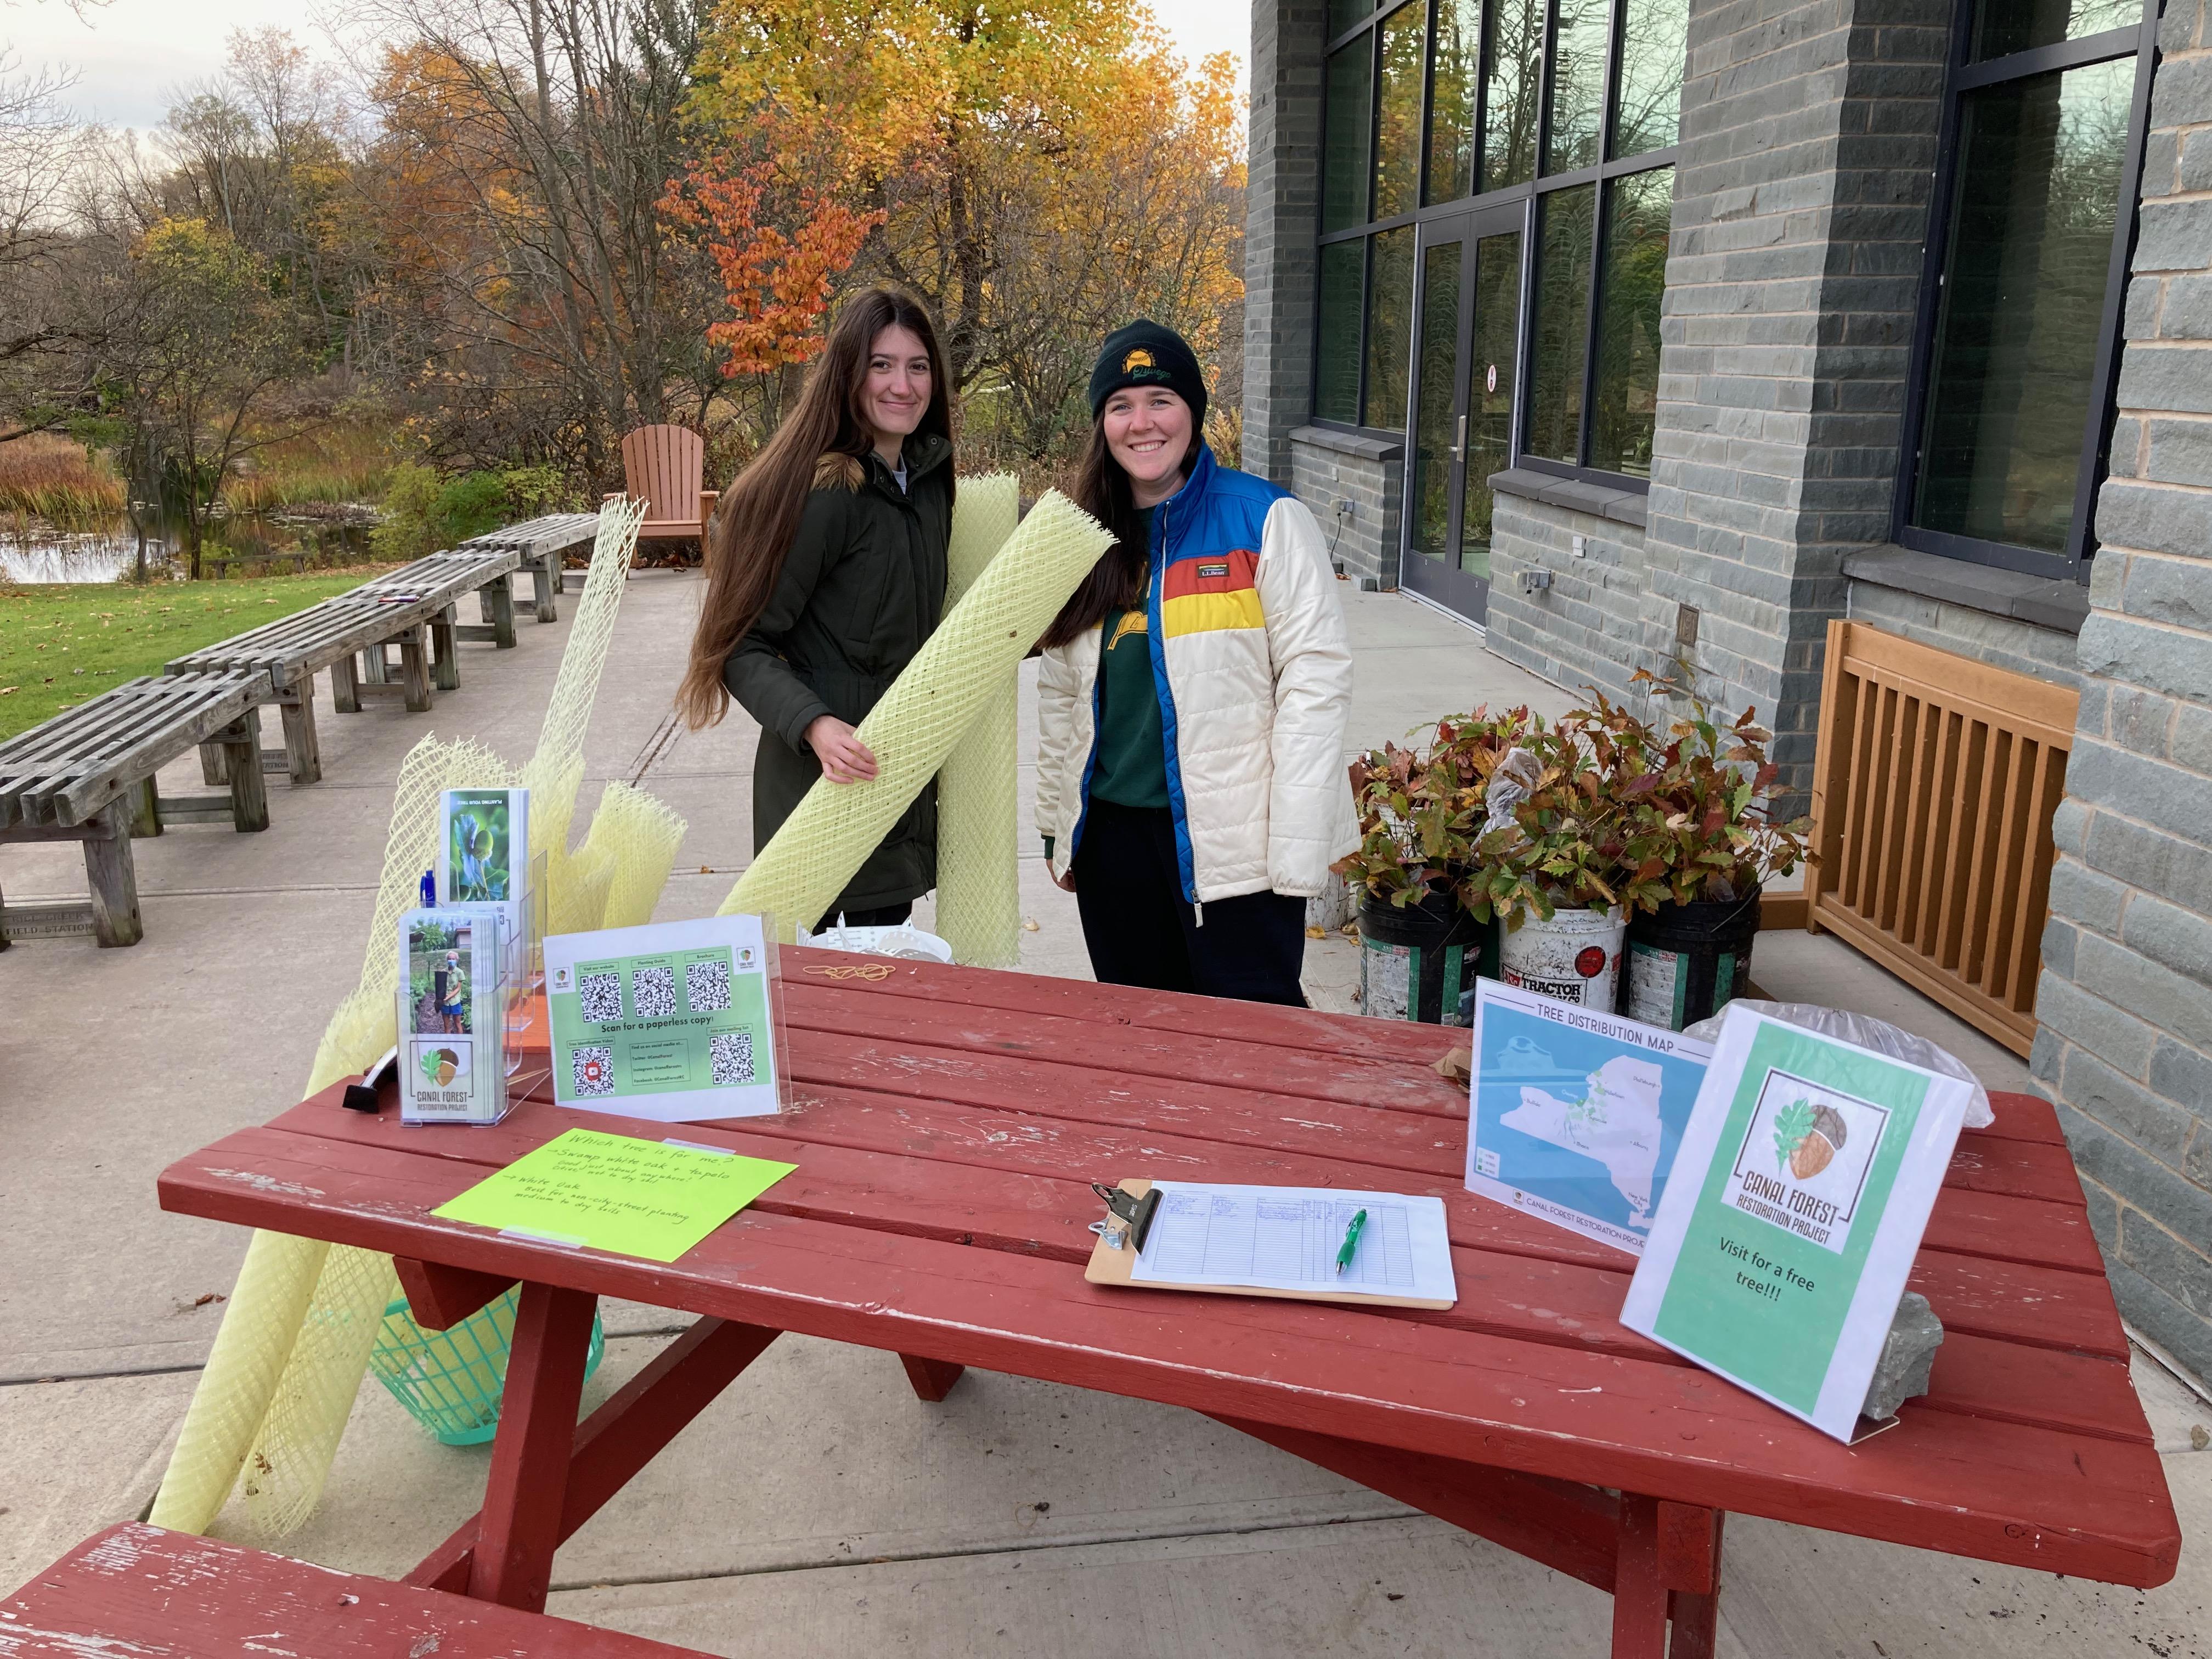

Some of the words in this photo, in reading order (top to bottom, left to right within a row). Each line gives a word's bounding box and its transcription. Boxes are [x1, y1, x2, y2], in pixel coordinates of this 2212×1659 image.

[1133, 365, 1171, 381] Oswego
[46, 912, 85, 921] CREEK
[6, 927, 38, 935] FIELD
[45, 923, 93, 933] STATION
[1522, 977, 1581, 995] TRACTOR
[647, 1018, 688, 1030] paperless
[1537, 1004, 1564, 1022] TREE
[1568, 1013, 1643, 1045] DISTRIBUTION
[1648, 1035, 1674, 1053] MAP
[417, 1091, 441, 1102] CANAL
[443, 1091, 468, 1103] FOREST
[569, 1135, 613, 1147] Which
[623, 1143, 647, 1152] tree
[670, 1150, 690, 1159] for
[557, 1149, 601, 1163] Swamp
[606, 1156, 640, 1165] white
[689, 1167, 730, 1180] tupelo
[607, 1166, 637, 1174] about
[621, 1175, 636, 1183] dry
[515, 1192, 554, 1201] medium
[574, 1202, 592, 1212] dry
[548, 1189, 564, 1197] for
[645, 1209, 689, 1224] planting
[1639, 1195, 1648, 1203] York
[1742, 1170, 1786, 1205] CANAL
[1787, 1189, 1840, 1227] FOREST
[1527, 1198, 1548, 1212] CANAL
[1550, 1206, 1576, 1222] FOREST
[1576, 1217, 1622, 1239] RESTORATION
[1623, 1234, 1645, 1249] PROJE
[1736, 1194, 1792, 1228] RESTORATION
[1791, 1217, 1831, 1245] PROJECT
[1720, 1237, 1749, 1261] Visit
[1751, 1251, 1772, 1271] for
[1774, 1266, 1782, 1277] a
[1786, 1268, 1815, 1292] free
[1736, 1271, 1781, 1302] tree!!!
